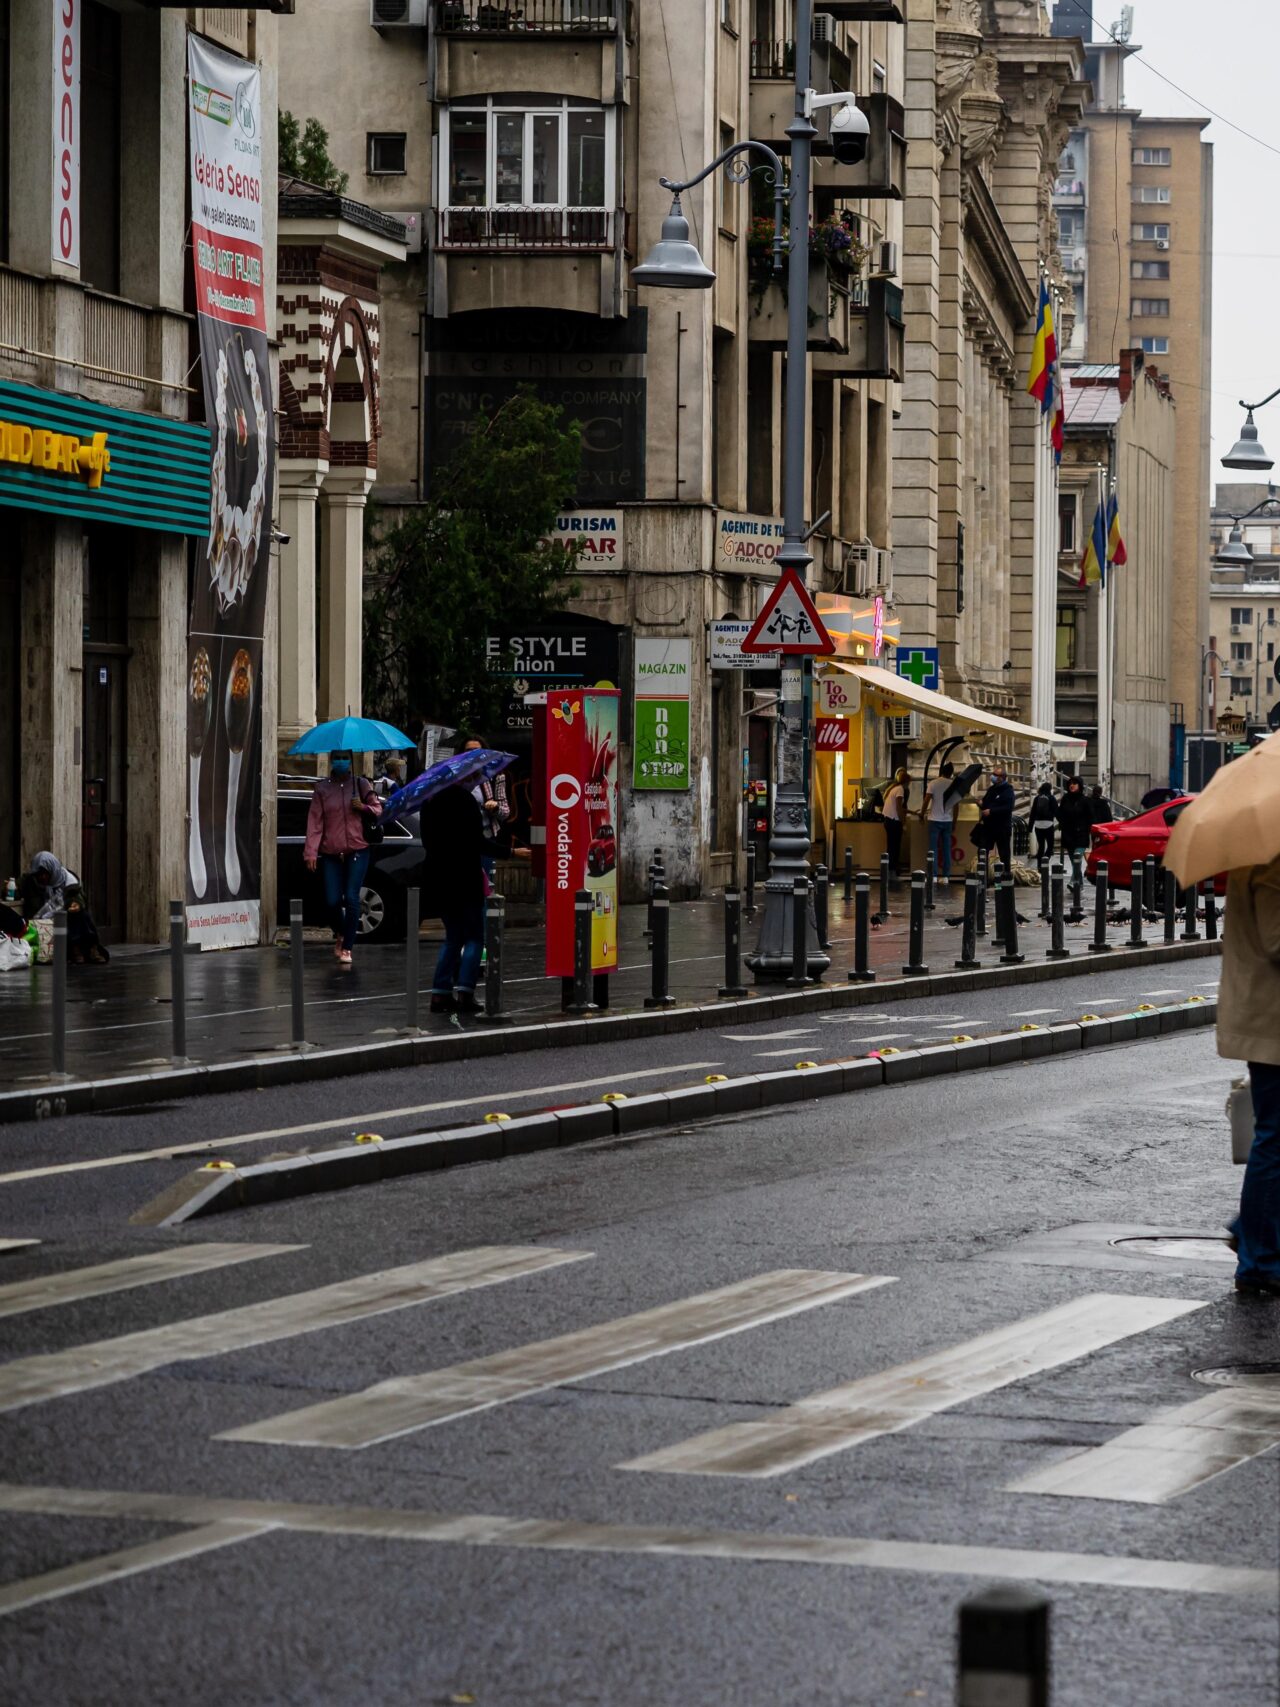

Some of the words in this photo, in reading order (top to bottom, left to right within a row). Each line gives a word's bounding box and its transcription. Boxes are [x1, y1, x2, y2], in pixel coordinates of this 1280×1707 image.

[226, 163, 260, 204] Senso
[561, 391, 642, 405] COMPANY
[33, 429, 80, 474] BAR
[557, 517, 616, 531] URISM
[761, 523, 772, 537] DE
[735, 556, 766, 565] TRAVEL
[509, 637, 587, 656] STYLE
[638, 663, 686, 675] MAGAZIN
[823, 680, 842, 694] To
[829, 694, 847, 708] go
[817, 723, 847, 749] illy
[557, 812, 573, 890] vodafone
